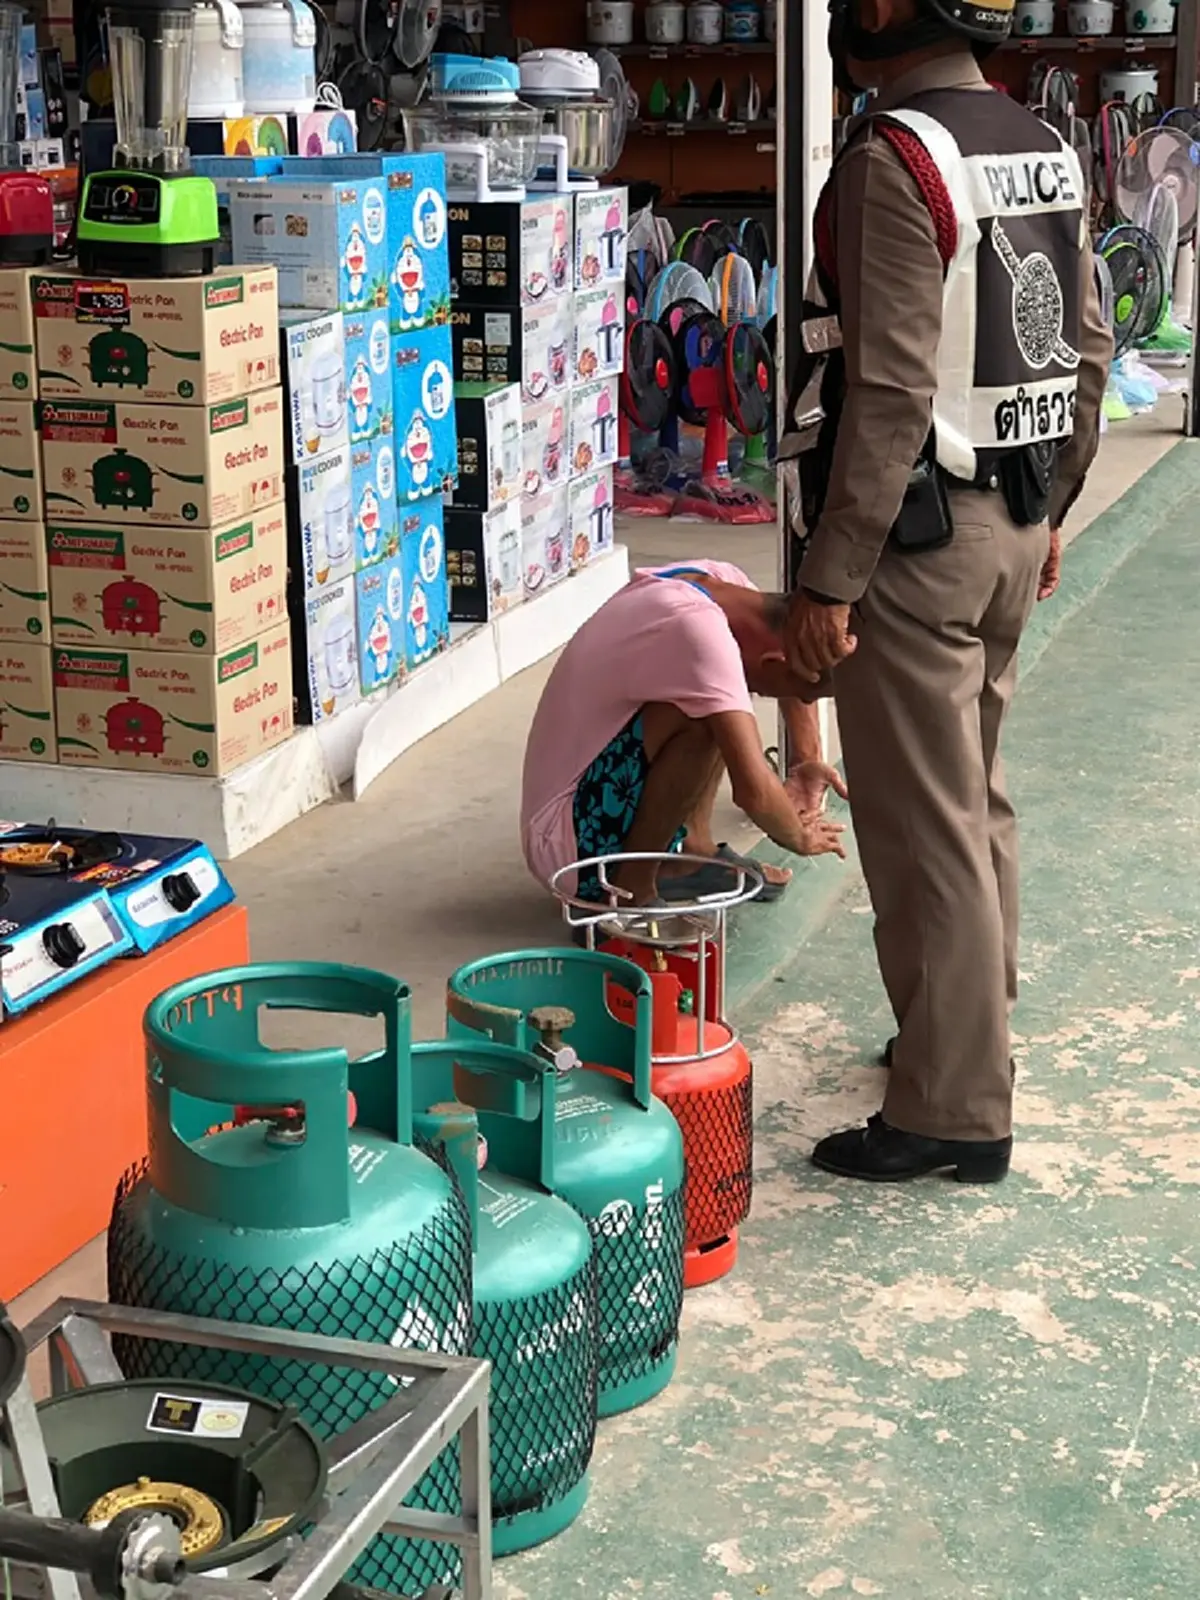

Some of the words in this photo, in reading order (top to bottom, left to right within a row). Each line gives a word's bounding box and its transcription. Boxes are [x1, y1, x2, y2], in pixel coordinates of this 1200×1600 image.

[984, 162, 1075, 207] POLICE
[155, 295, 175, 306] Pan
[220, 326, 247, 347] Electric
[248, 322, 263, 340] Pan
[57, 409, 108, 422] MITSUMARU
[122, 417, 157, 430] Electric
[159, 419, 179, 431] Pan
[225, 447, 251, 469] Electric
[253, 444, 268, 462] Pan
[131, 545, 163, 557] Electric
[166, 547, 186, 558] Pan
[304, 522, 314, 590] KASHIWA
[230, 569, 256, 593] Electric
[258, 564, 272, 580] Pan
[135, 667, 168, 679] Electric
[171, 669, 190, 681] Pan
[234, 688, 261, 713] Electric
[263, 683, 278, 700] Pan
